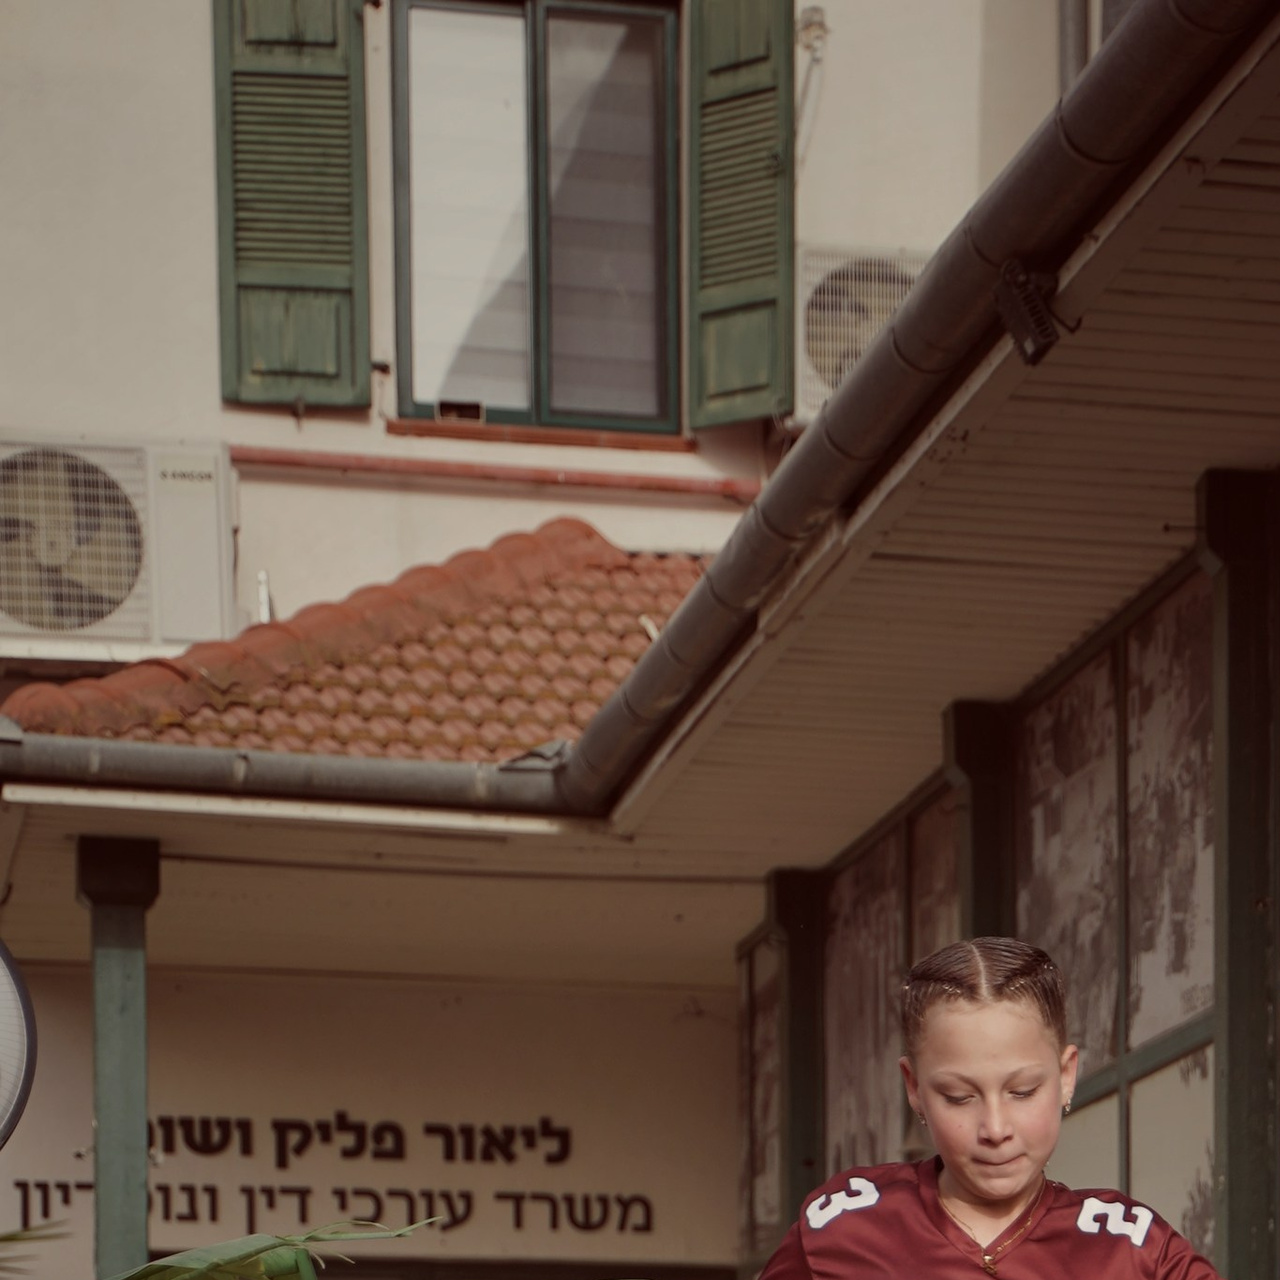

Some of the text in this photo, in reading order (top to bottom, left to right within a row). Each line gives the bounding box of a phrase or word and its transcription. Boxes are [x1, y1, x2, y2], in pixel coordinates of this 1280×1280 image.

[271, 1109, 406, 1170] פליק
[423, 1115, 573, 1166] ליאור
[240, 1184, 313, 1236] דין
[331, 1186, 474, 1232] עורכי
[494, 1190, 655, 1233] משרד
